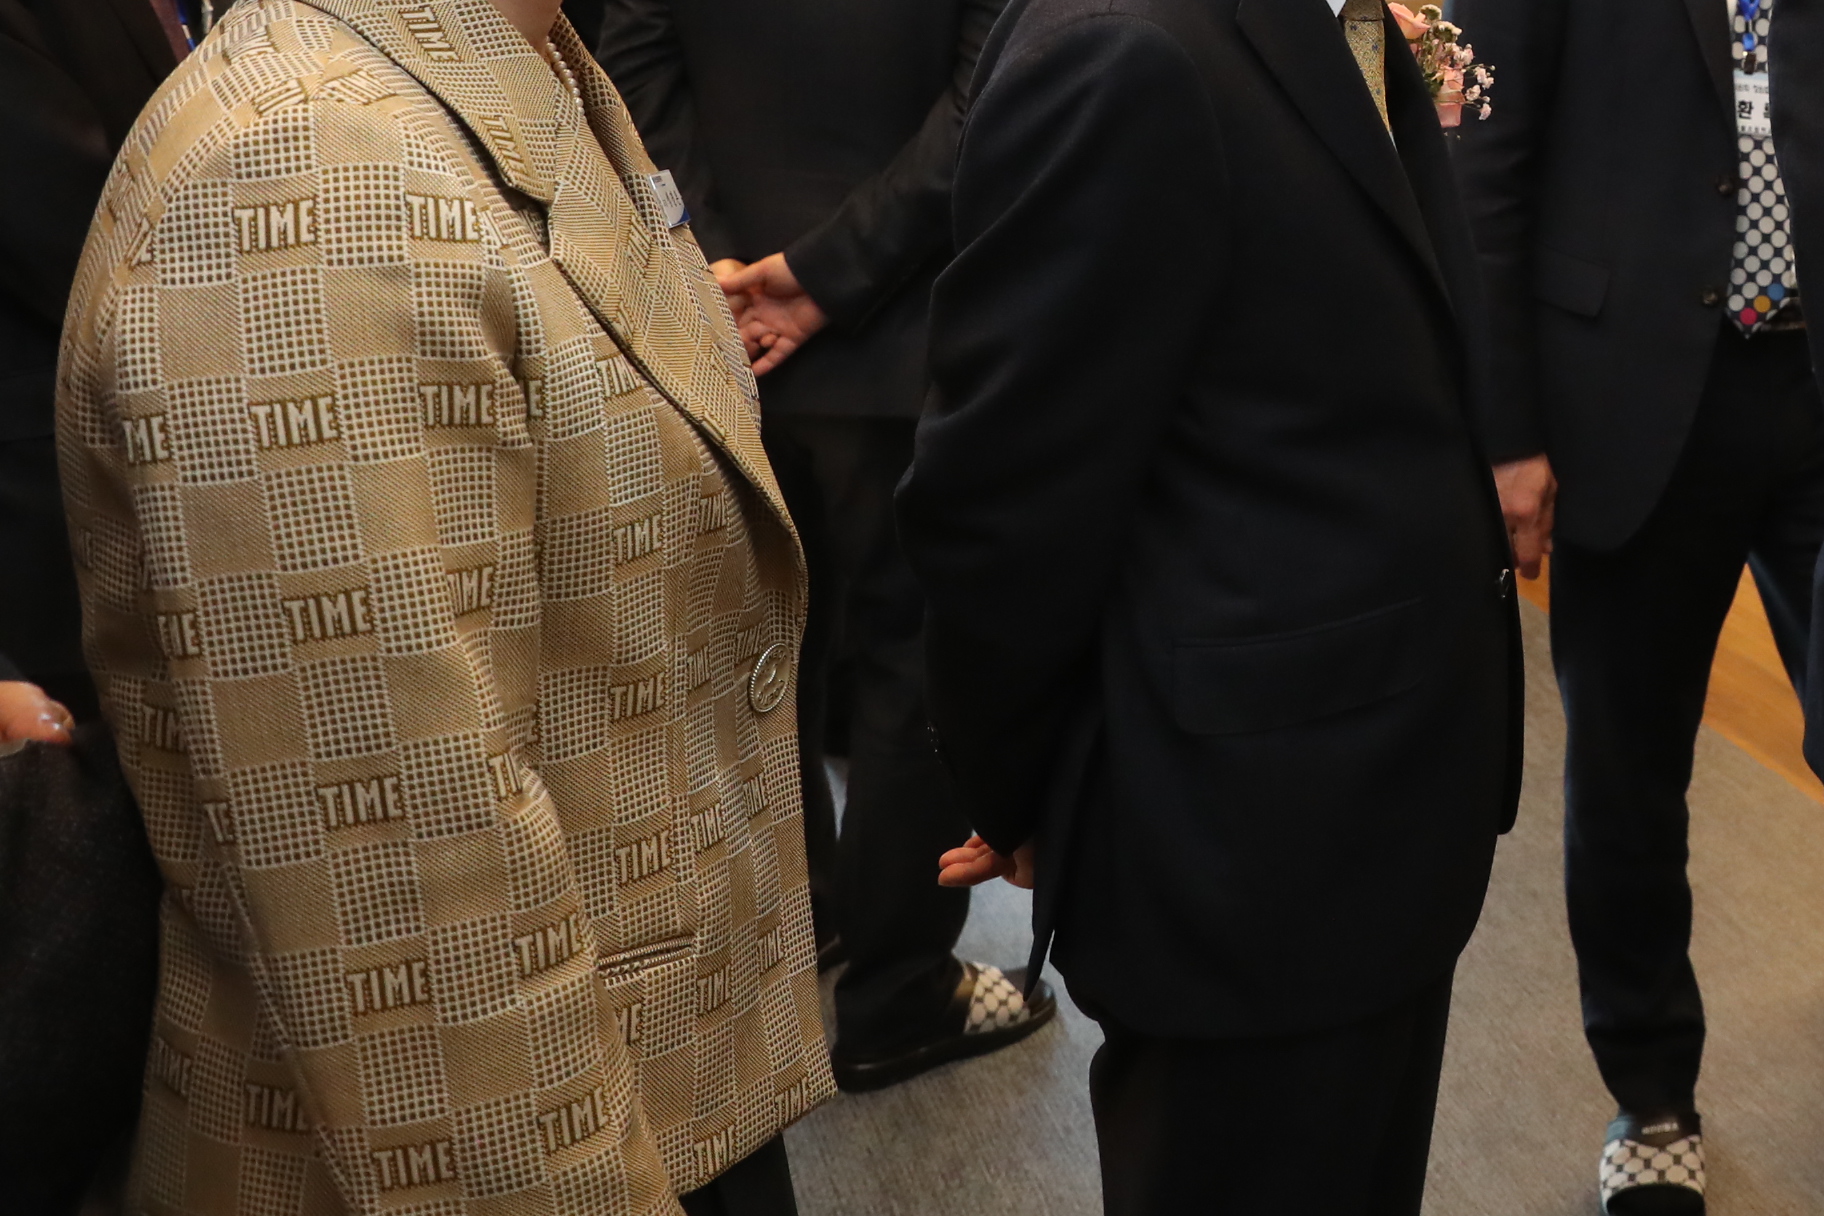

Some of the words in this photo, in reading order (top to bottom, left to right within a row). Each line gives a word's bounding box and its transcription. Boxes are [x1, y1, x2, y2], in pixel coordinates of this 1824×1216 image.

[401, 6, 461, 62] TIME
[483, 117, 527, 176] TIME
[234, 199, 316, 252] TIME
[407, 195, 480, 241] TIME
[250, 395, 338, 449] TIME
[421, 384, 494, 426] TIME
[613, 515, 663, 564] TIME
[284, 590, 372, 642] TIME
[610, 675, 665, 721] TIME
[319, 778, 399, 828] TIME
[615, 832, 673, 884] TIME
[346, 961, 430, 1014] TIME
[373, 1142, 456, 1190] TIME
